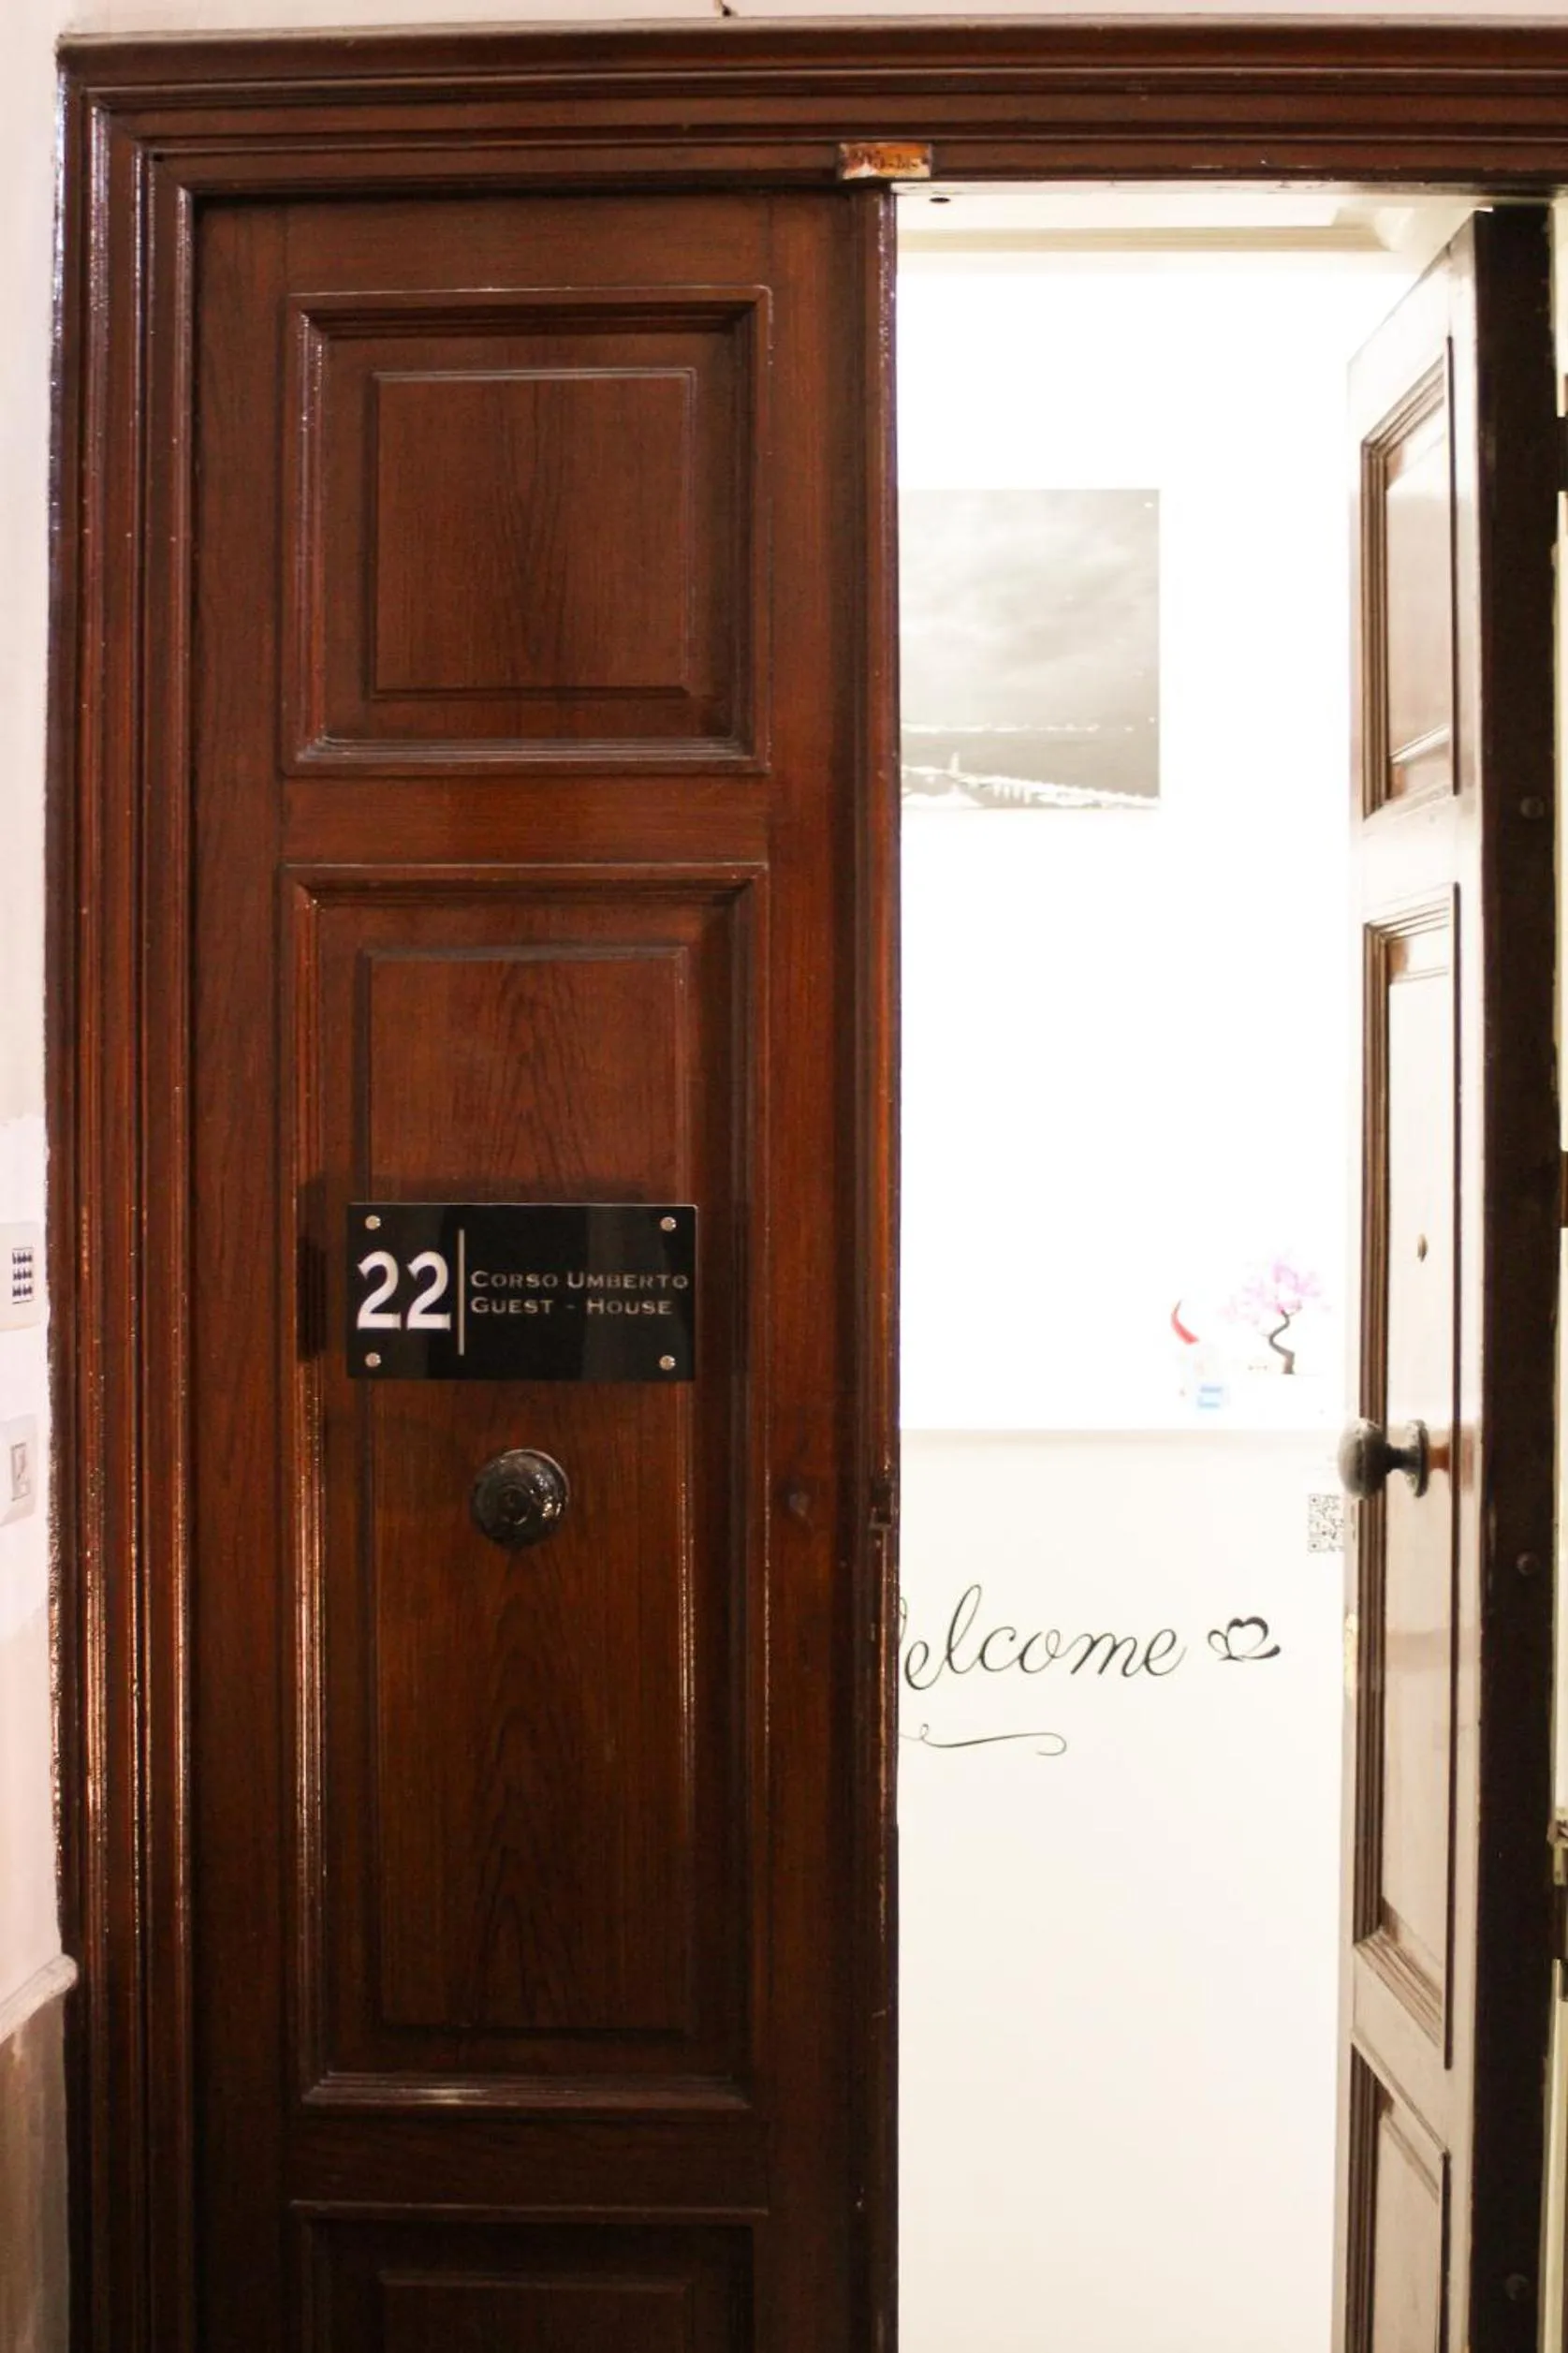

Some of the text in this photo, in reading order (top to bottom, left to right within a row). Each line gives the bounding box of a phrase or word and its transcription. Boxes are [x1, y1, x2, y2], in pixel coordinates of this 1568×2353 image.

[357, 1251, 451, 1331] 22
[470, 1270, 690, 1290] CORSO UMBERTO
[470, 1296, 554, 1316] GUEST
[585, 1297, 674, 1316] HOUSE
[899, 1583, 1187, 1691] elcome
